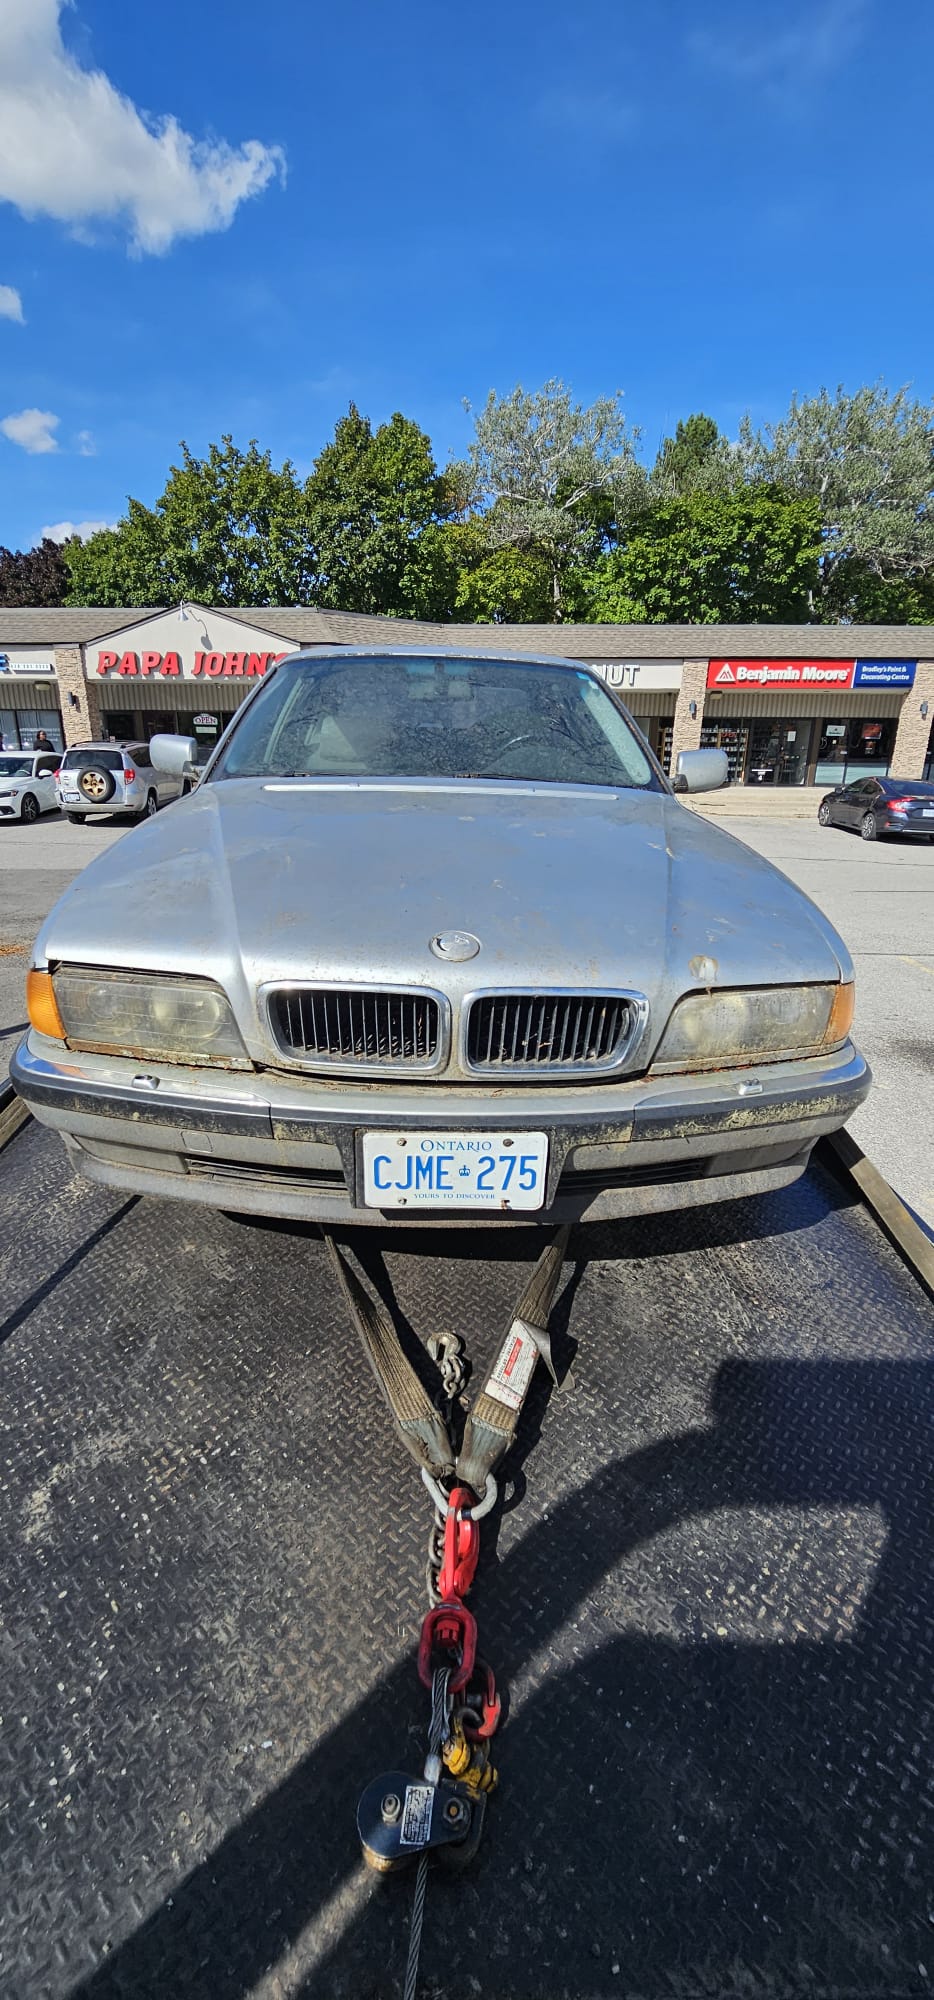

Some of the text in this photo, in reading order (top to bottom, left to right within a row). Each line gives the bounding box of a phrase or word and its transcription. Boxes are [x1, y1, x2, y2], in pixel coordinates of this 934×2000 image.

[96, 651, 180, 676] PAPA
[862, 666, 886, 674] Bradley's
[736, 666, 848, 684] Benjamin Moore
[420, 1139, 492, 1153] ONTARIO
[373, 1155, 539, 1191] CJME 275
